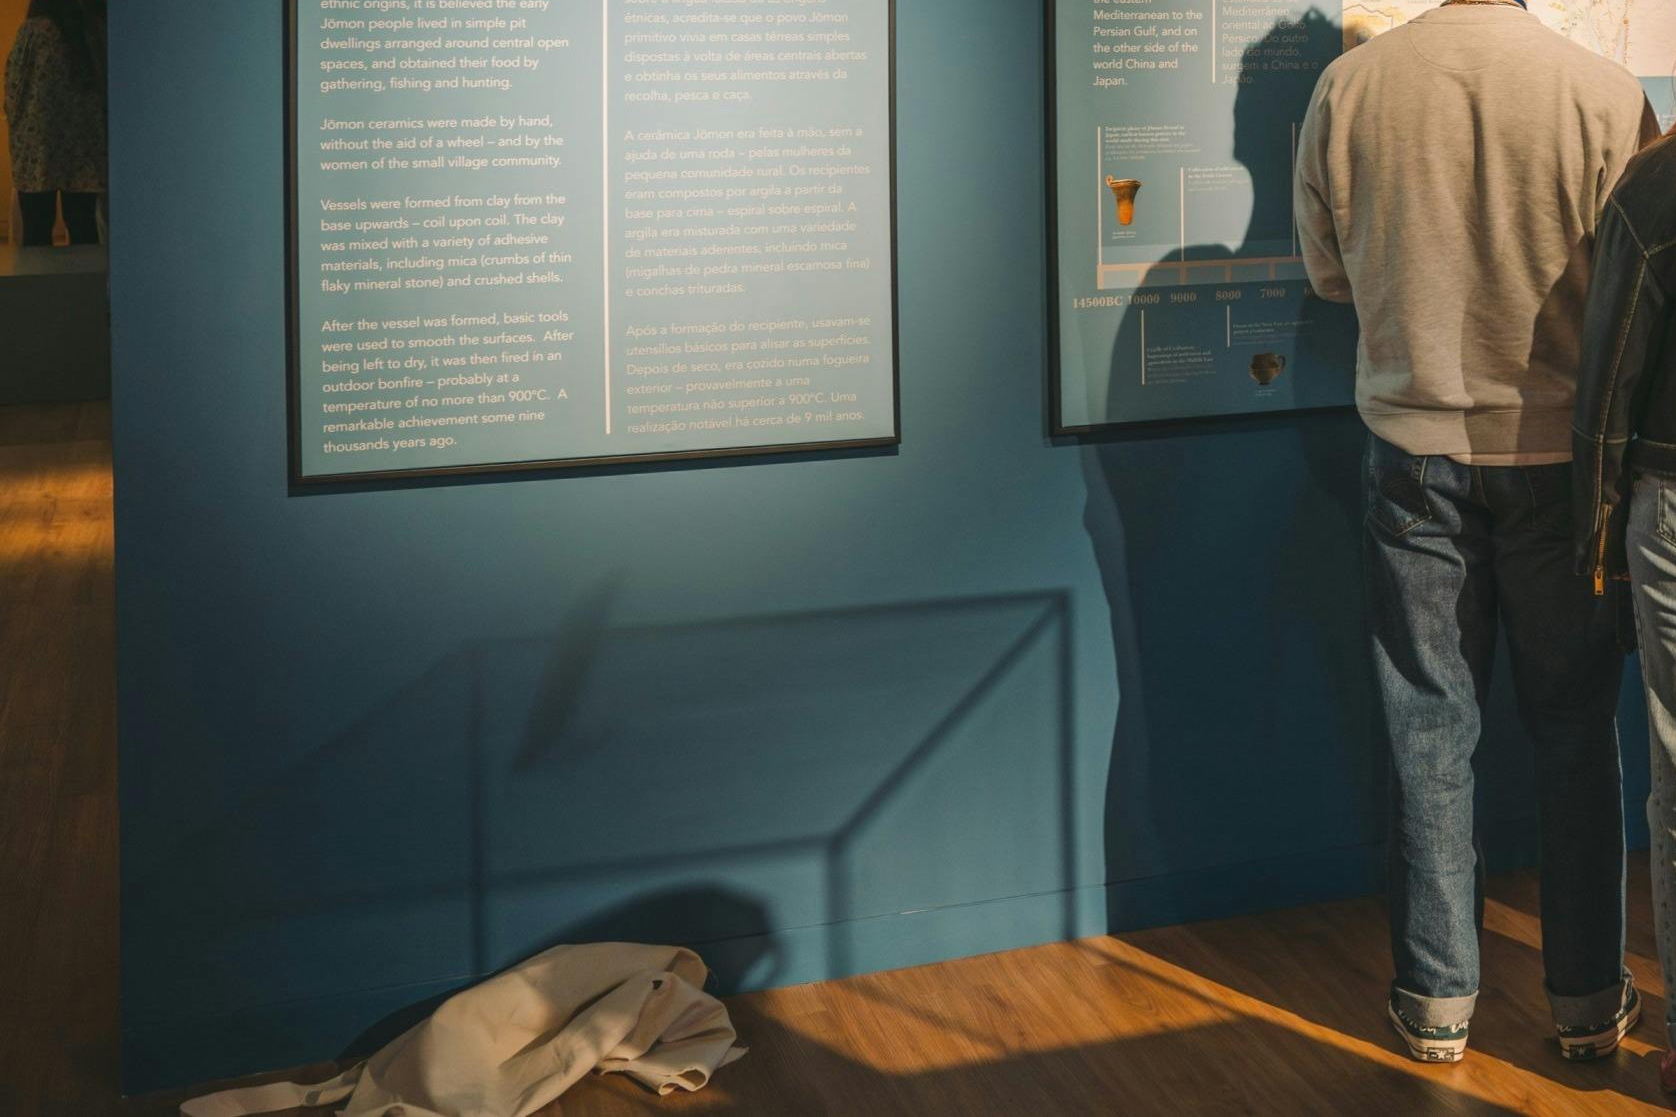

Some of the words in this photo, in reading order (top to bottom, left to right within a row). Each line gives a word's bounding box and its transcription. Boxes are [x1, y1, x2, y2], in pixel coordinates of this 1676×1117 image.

[1092, 41, 1110, 52] the
[1112, 41, 1142, 52] other
[1143, 41, 1165, 52] side
[1167, 41, 1179, 51] of
[1181, 41, 1198, 52] the
[1092, 58, 1122, 69] world
[1124, 58, 1154, 68] China
[1158, 57, 1178, 68] and
[1092, 75, 1127, 88] Japan.
[1170, 292, 1196, 303] 9000
[1215, 289, 1241, 300] 8000
[1259, 287, 1285, 298] 7000
[1072, 295, 1124, 308] 14500BC
[1126, 293, 1160, 306] 10000
[322, 417, 394, 433] remarkable
[397, 414, 478, 428] achievement
[481, 413, 515, 425] some
[518, 410, 544, 420] nine
[323, 437, 389, 453] thousands
[392, 438, 426, 451] years
[429, 436, 456, 448] ago.
